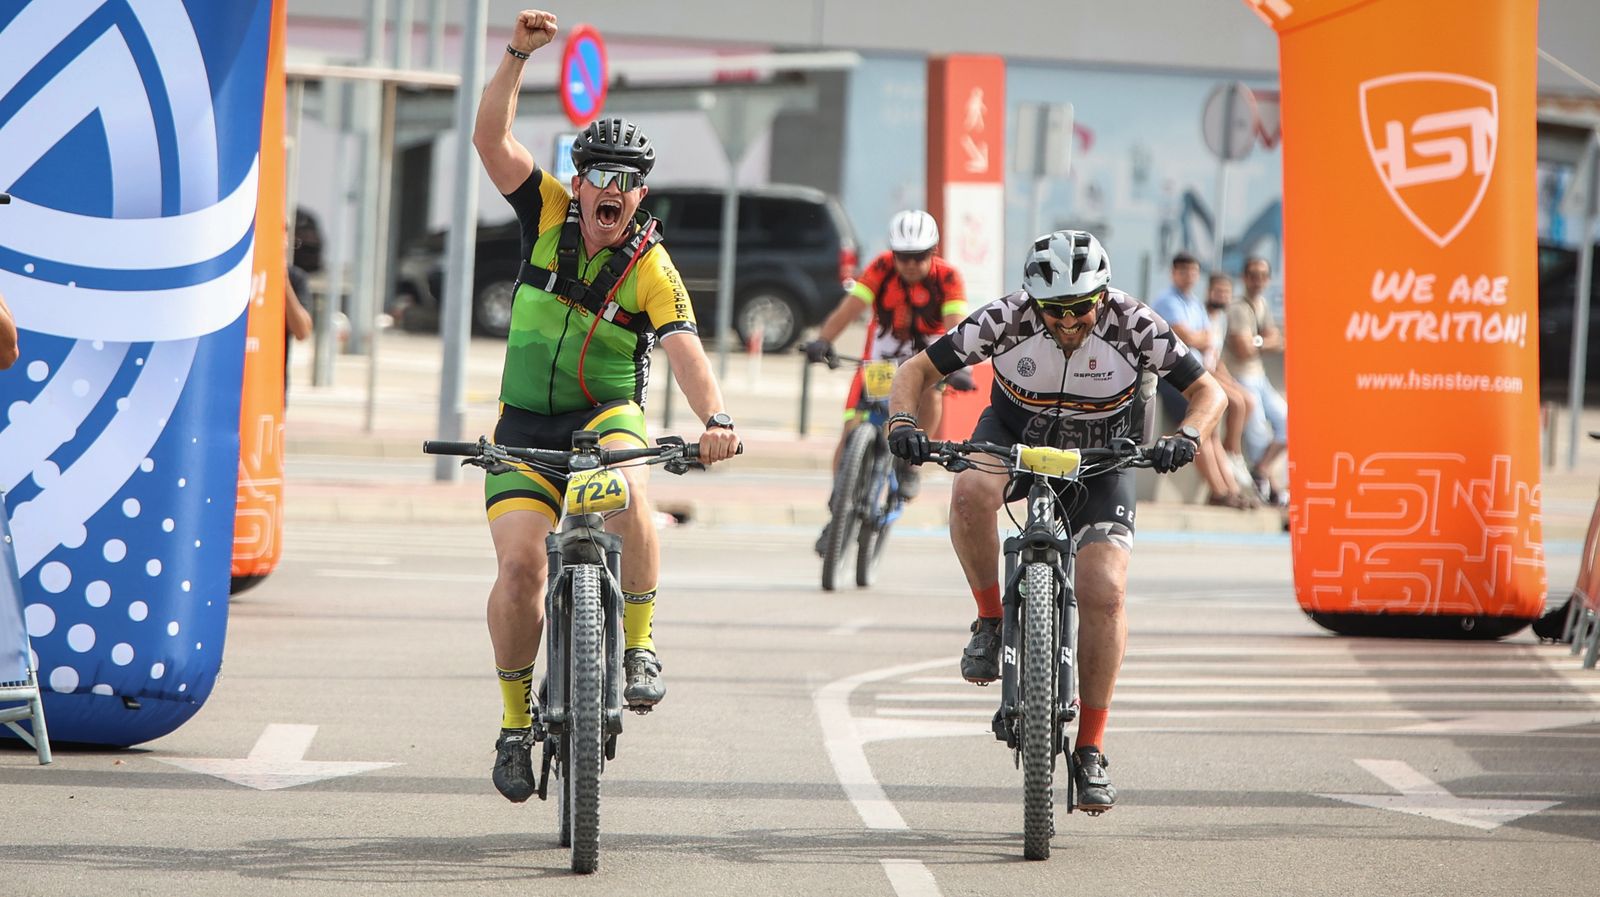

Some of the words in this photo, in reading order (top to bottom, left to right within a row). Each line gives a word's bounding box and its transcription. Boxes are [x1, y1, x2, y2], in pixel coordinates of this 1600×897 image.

[1371, 268, 1437, 304] WE
[1449, 274, 1509, 306] ARE
[1345, 310, 1528, 348] NUTRITION!
[1356, 370, 1524, 394] www.hsnstore.com
[571, 479, 622, 504] 724
